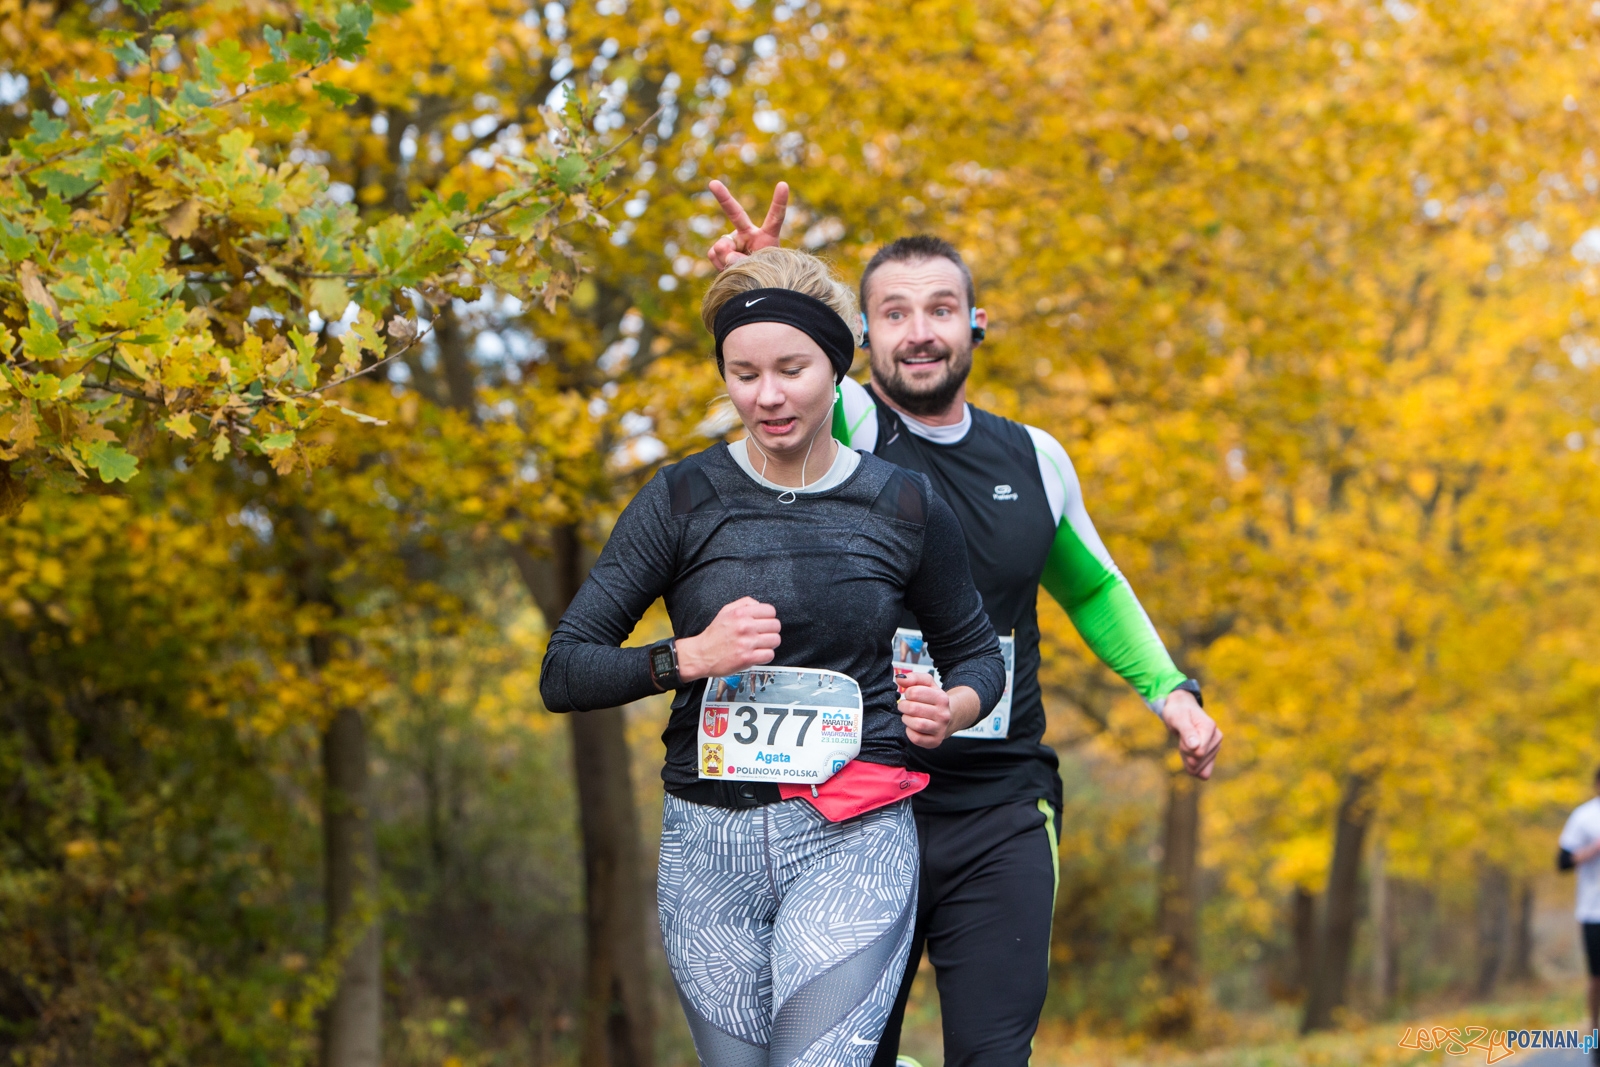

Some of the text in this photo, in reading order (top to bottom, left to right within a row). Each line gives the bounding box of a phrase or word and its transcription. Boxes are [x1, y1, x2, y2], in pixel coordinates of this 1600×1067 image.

[733, 705, 818, 747] 377
[821, 719, 854, 727] MARATON
[821, 737, 858, 745] 23.10.2016
[755, 751, 791, 764] Agata
[736, 766, 781, 776] POLINOVA
[783, 769, 819, 778] POLSKA
